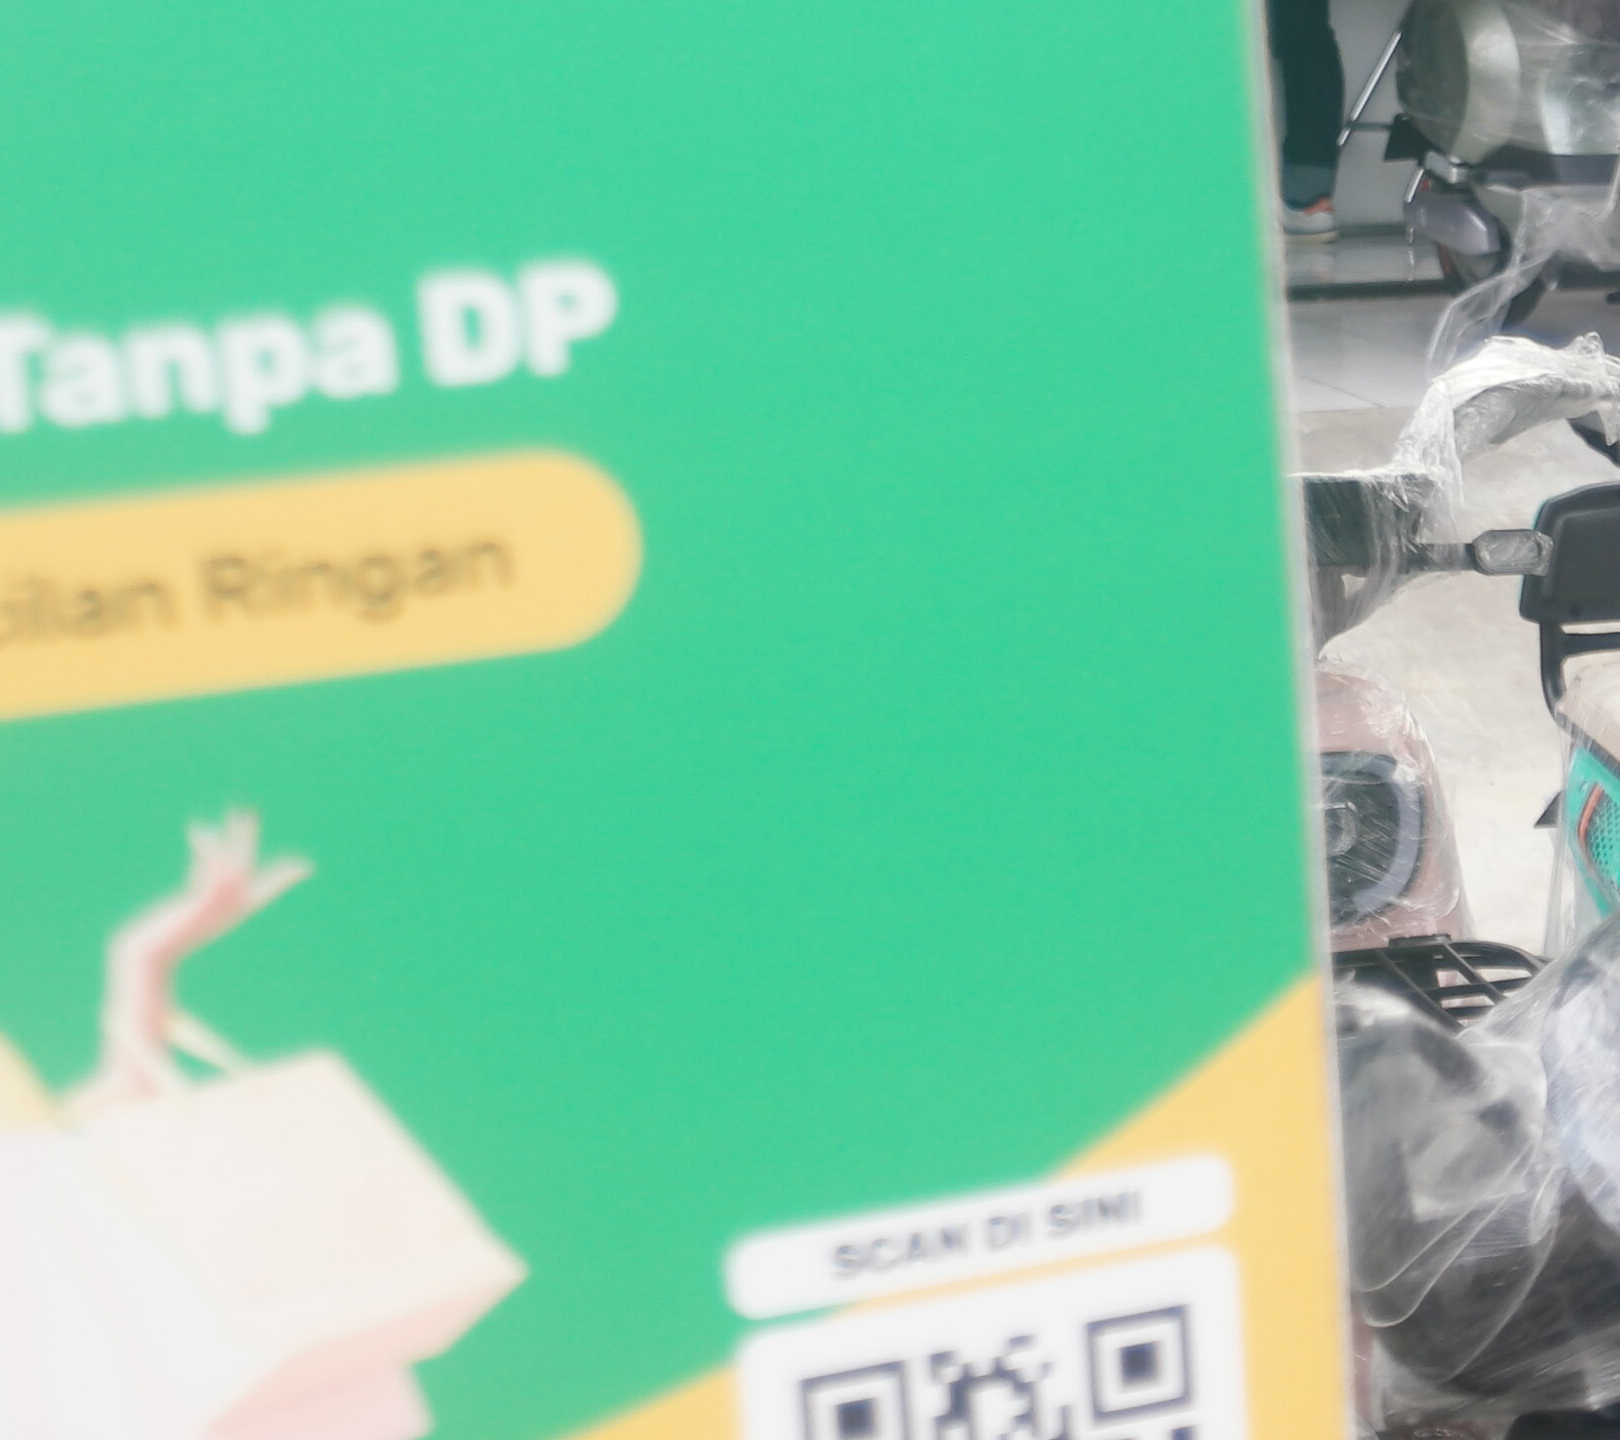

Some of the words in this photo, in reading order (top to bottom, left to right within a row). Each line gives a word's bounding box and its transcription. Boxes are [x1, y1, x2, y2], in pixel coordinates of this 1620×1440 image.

[418, 259, 619, 389] DP
[203, 517, 518, 642] Ringan
[831, 1221, 967, 1282] SCAN
[985, 1209, 1033, 1253] DI
[1048, 1188, 1143, 1242] SINI
